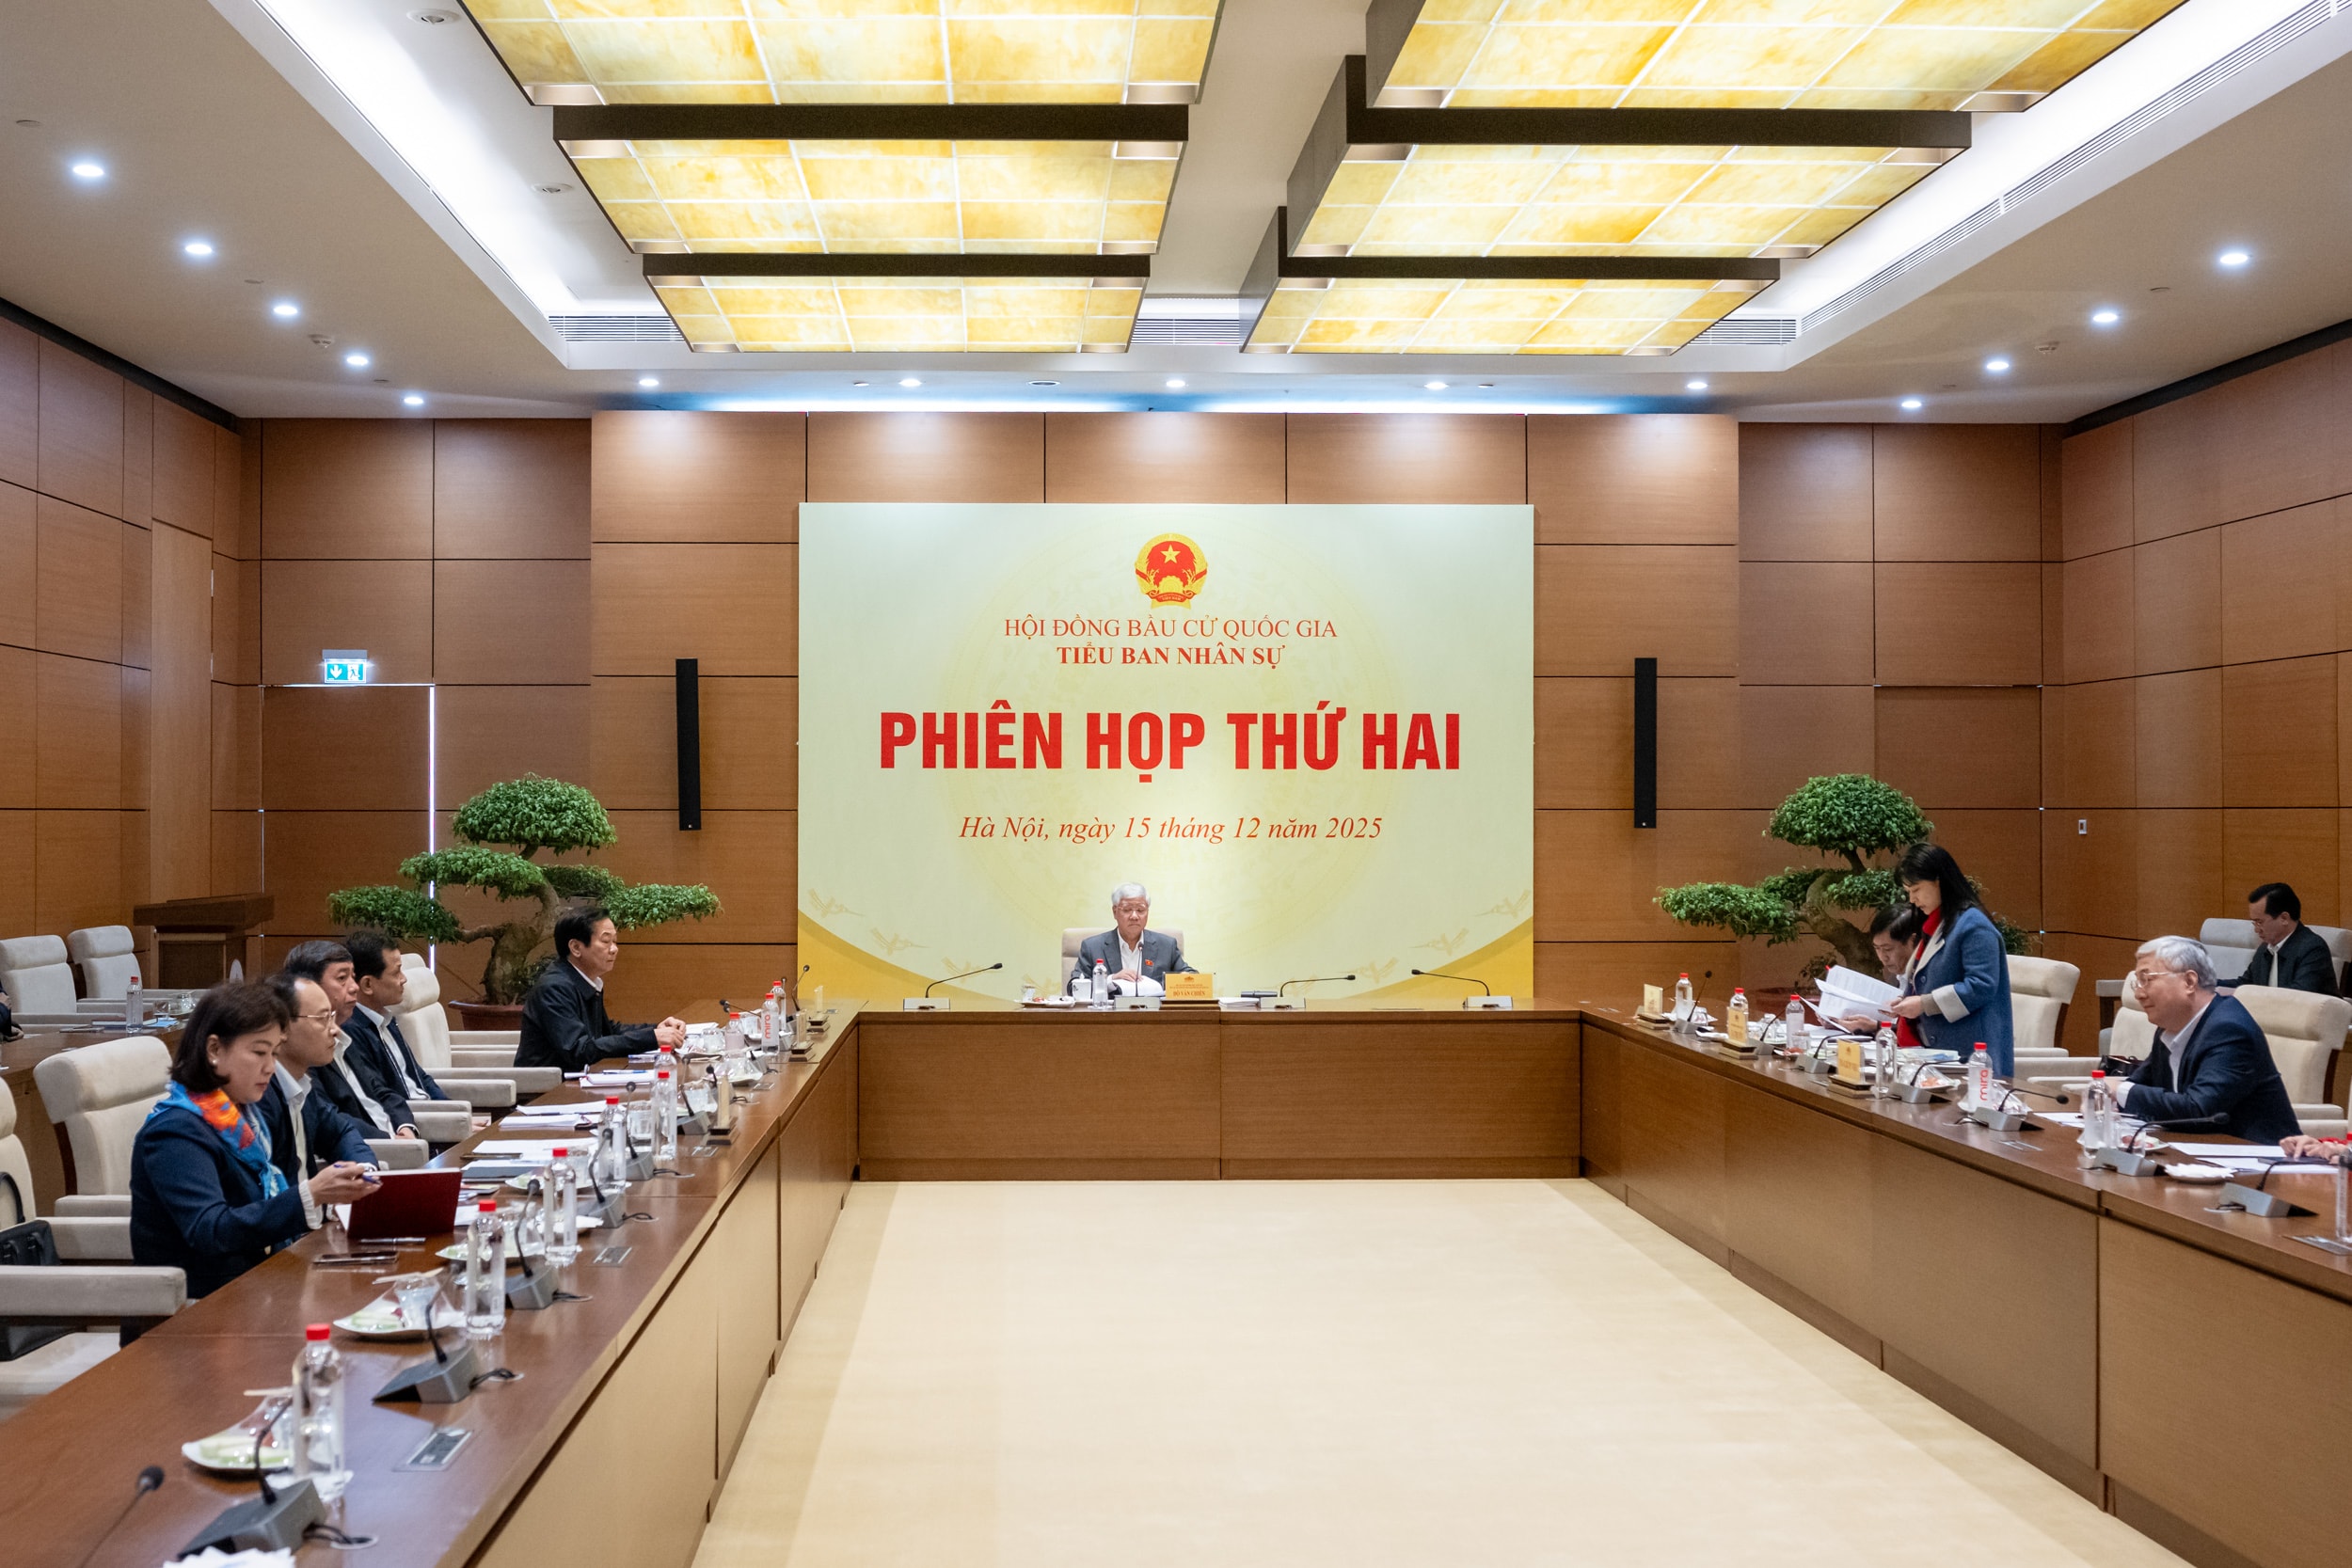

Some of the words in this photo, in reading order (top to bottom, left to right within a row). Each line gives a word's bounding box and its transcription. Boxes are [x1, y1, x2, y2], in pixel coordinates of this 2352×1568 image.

[1005, 613, 1046, 640] HỘI
[1053, 614, 1120, 638] ĐỒNG
[1127, 614, 1176, 638] BẦU
[1183, 613, 1218, 638] CỬ
[1223, 614, 1289, 641] QUỐC
[1295, 620, 1337, 638] GIA
[1057, 641, 1113, 665] TIỂU
[1121, 646, 1169, 665] BAN
[1178, 641, 1246, 665] NHÂN
[1253, 645, 1285, 670] SỰ
[881, 700, 1063, 770] PHIÊN
[1087, 712, 1205, 784] HỌP
[1227, 701, 1347, 771] THỨ
[1362, 712, 1460, 770] HAI
[960, 816, 995, 838] Hà
[1003, 816, 1049, 843] Nội,
[1058, 817, 1116, 844] ngày
[1125, 816, 1152, 839] 15
[1159, 816, 1225, 844] tháng
[1234, 816, 1261, 839] 12
[1267, 818, 1319, 839] năm
[1326, 816, 1383, 839] 2025
[1979, 1069, 1990, 1101] mira
